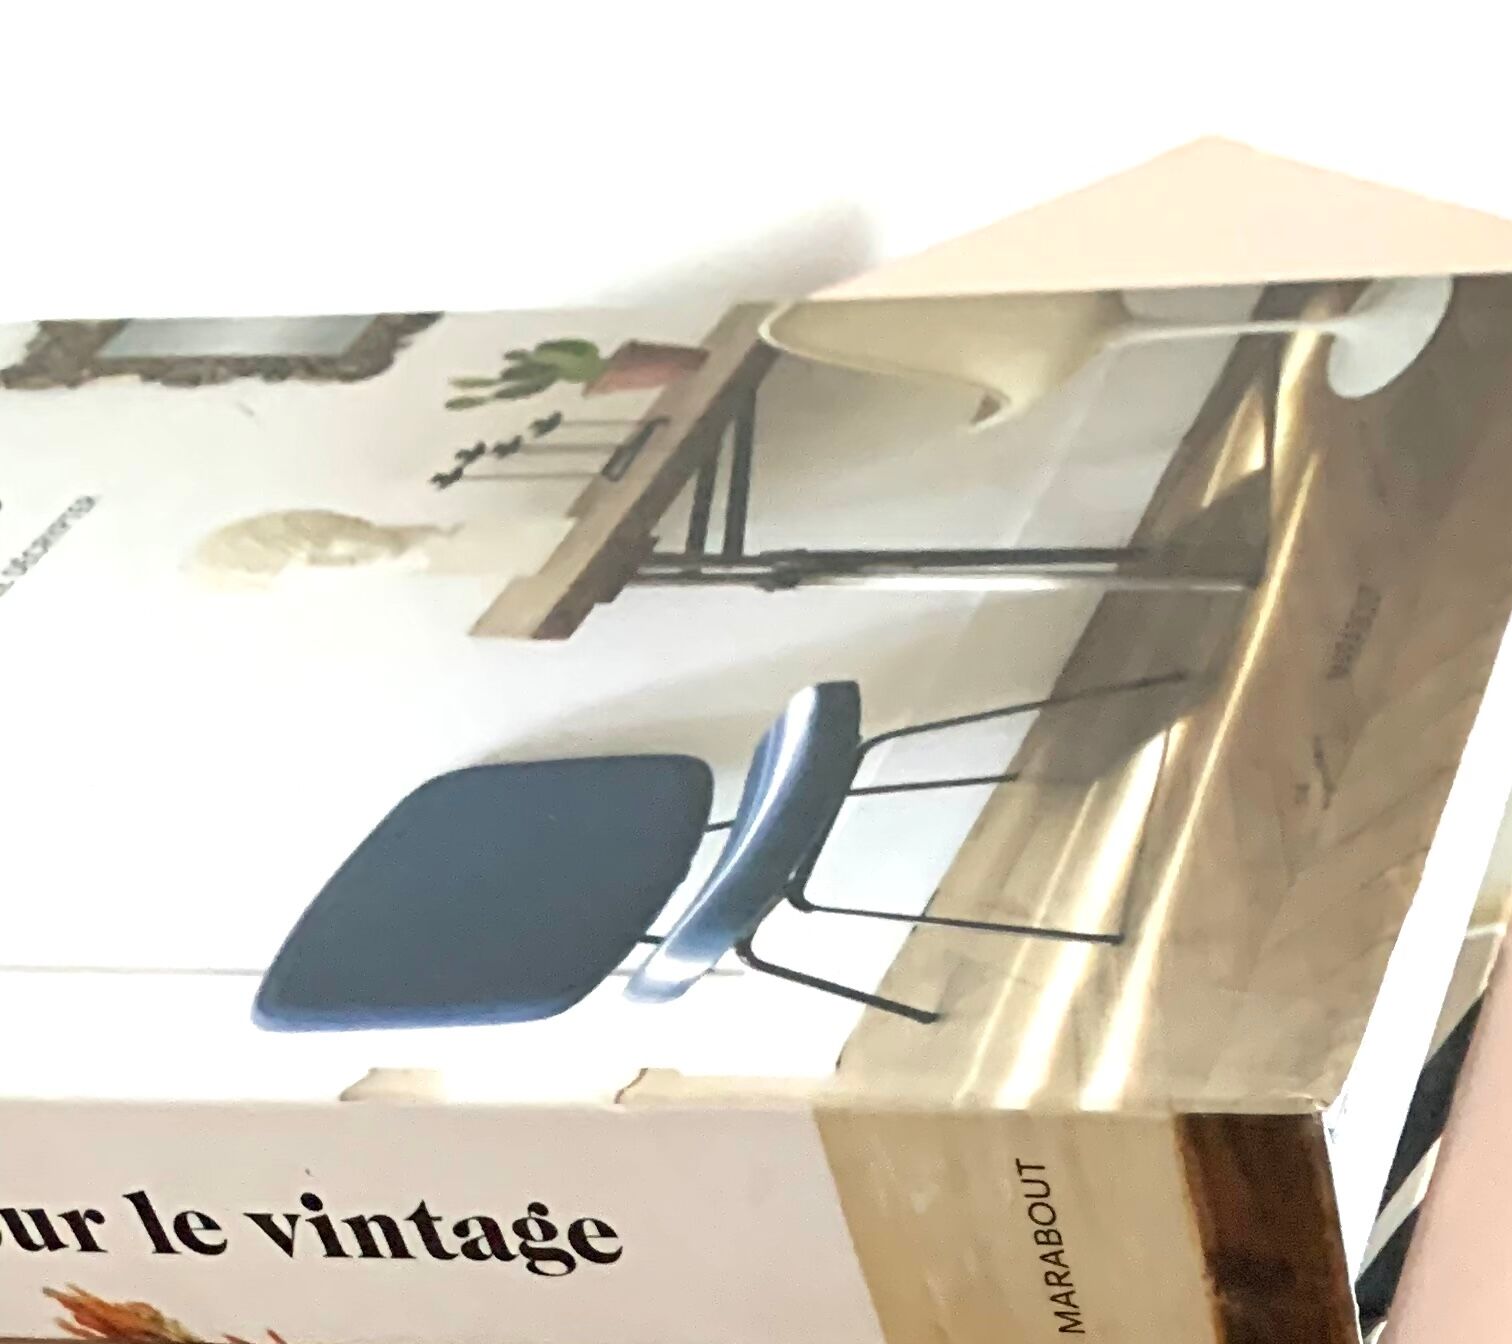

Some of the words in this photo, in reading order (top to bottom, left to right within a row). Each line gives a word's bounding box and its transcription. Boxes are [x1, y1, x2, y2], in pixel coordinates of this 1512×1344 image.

[0, 1206, 108, 1254] ur
[122, 1190, 229, 1256] le
[243, 1192, 624, 1277] vintage
[1015, 1157, 1086, 1334] MARABOUT
